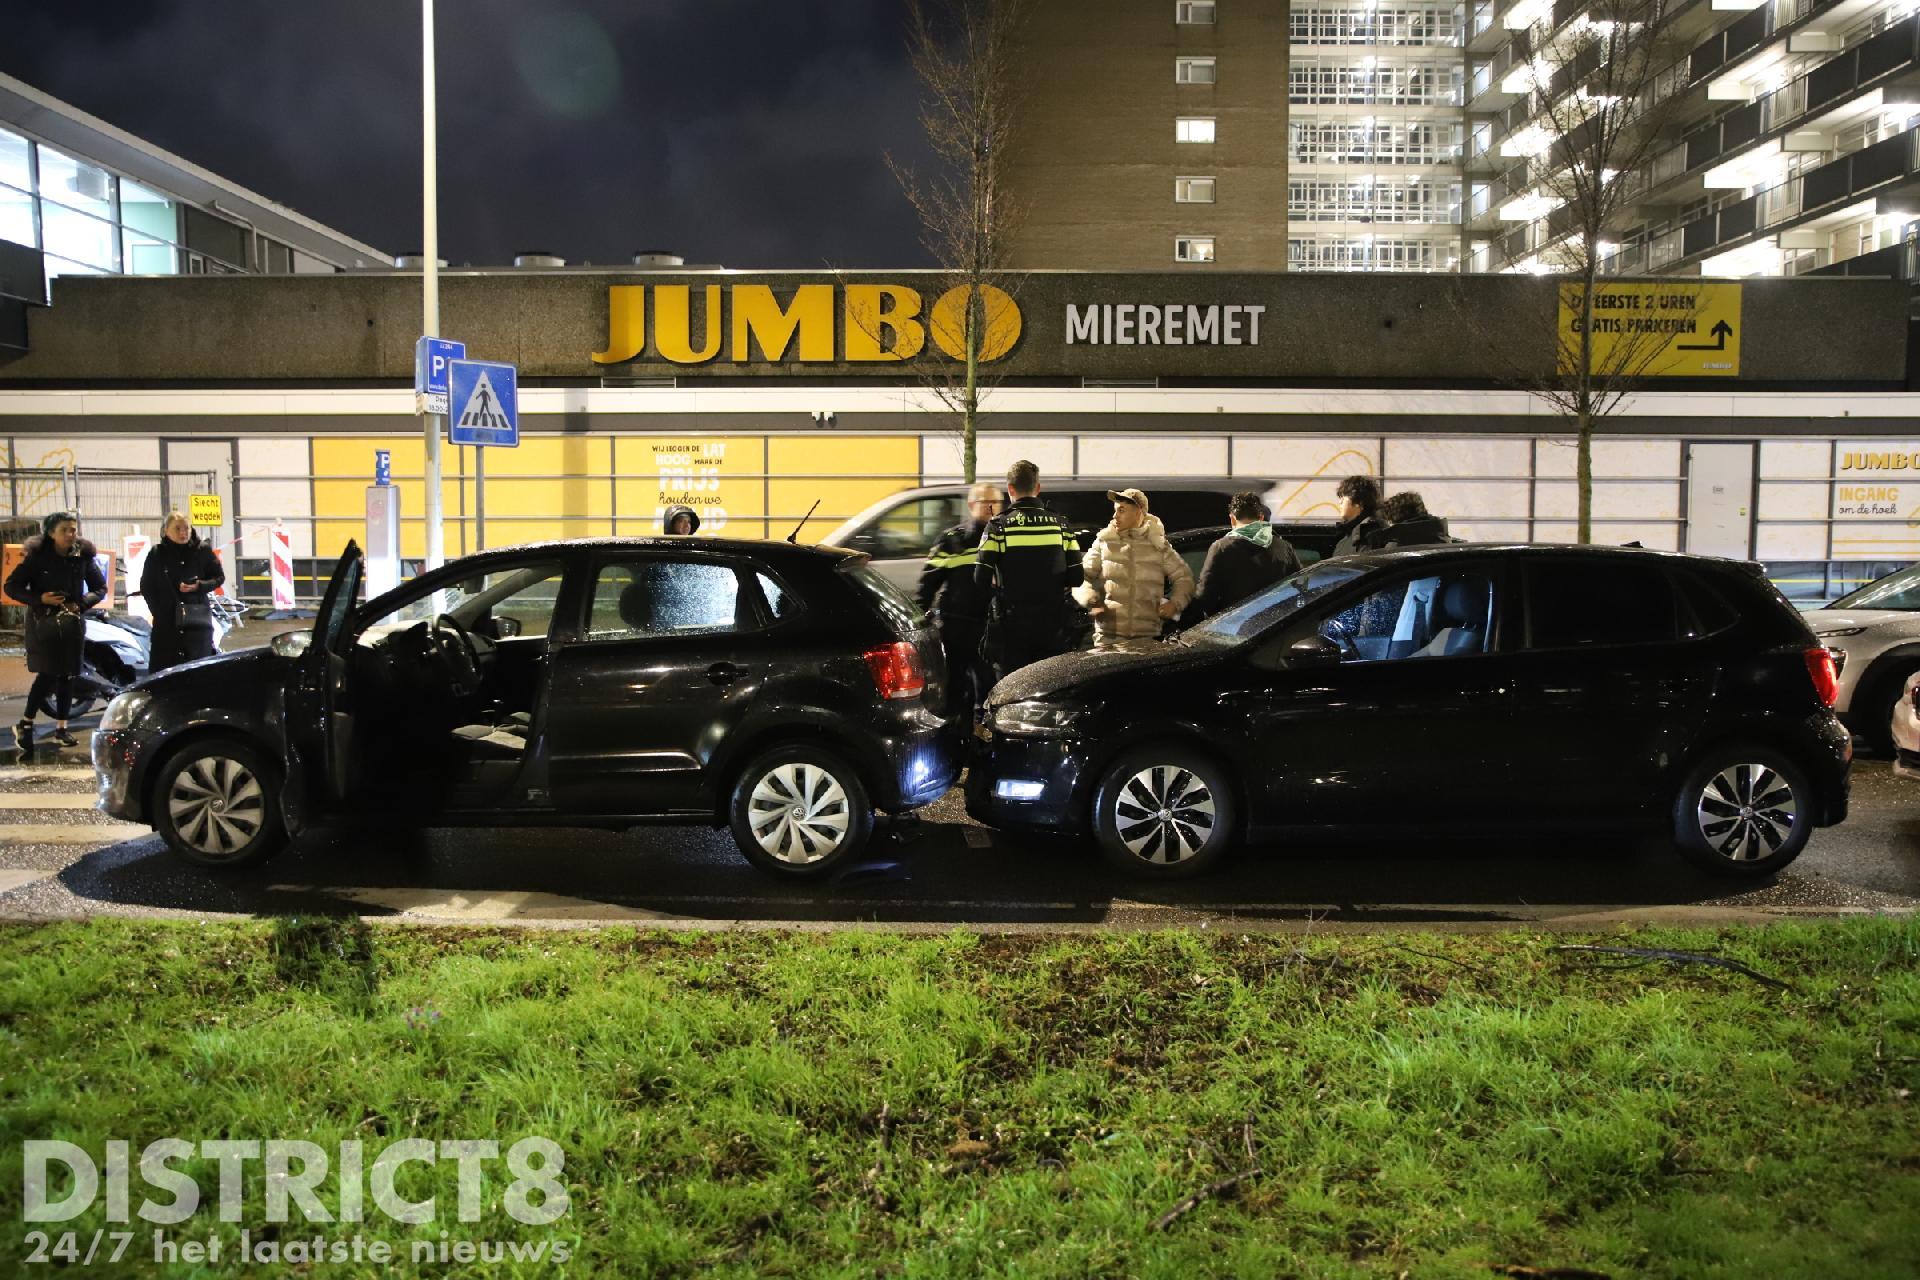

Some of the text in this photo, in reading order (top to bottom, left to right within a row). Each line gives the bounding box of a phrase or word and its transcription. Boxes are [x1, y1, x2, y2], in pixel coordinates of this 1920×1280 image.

[1595, 295, 1640, 310] EERSTE
[1646, 295, 1655, 309] 2
[1660, 296, 1696, 310] UREN
[592, 285, 1266, 364] JUMBO MIEREMET
[1571, 318, 1696, 333] GATIS PARKEREN
[432, 355, 445, 377] P
[1841, 452, 1920, 470] JUMBO
[658, 467, 720, 492] PRIJS
[659, 492, 722, 504] houden we
[1840, 487, 1899, 501] INGANG
[1839, 503, 1897, 514] om de hoek
